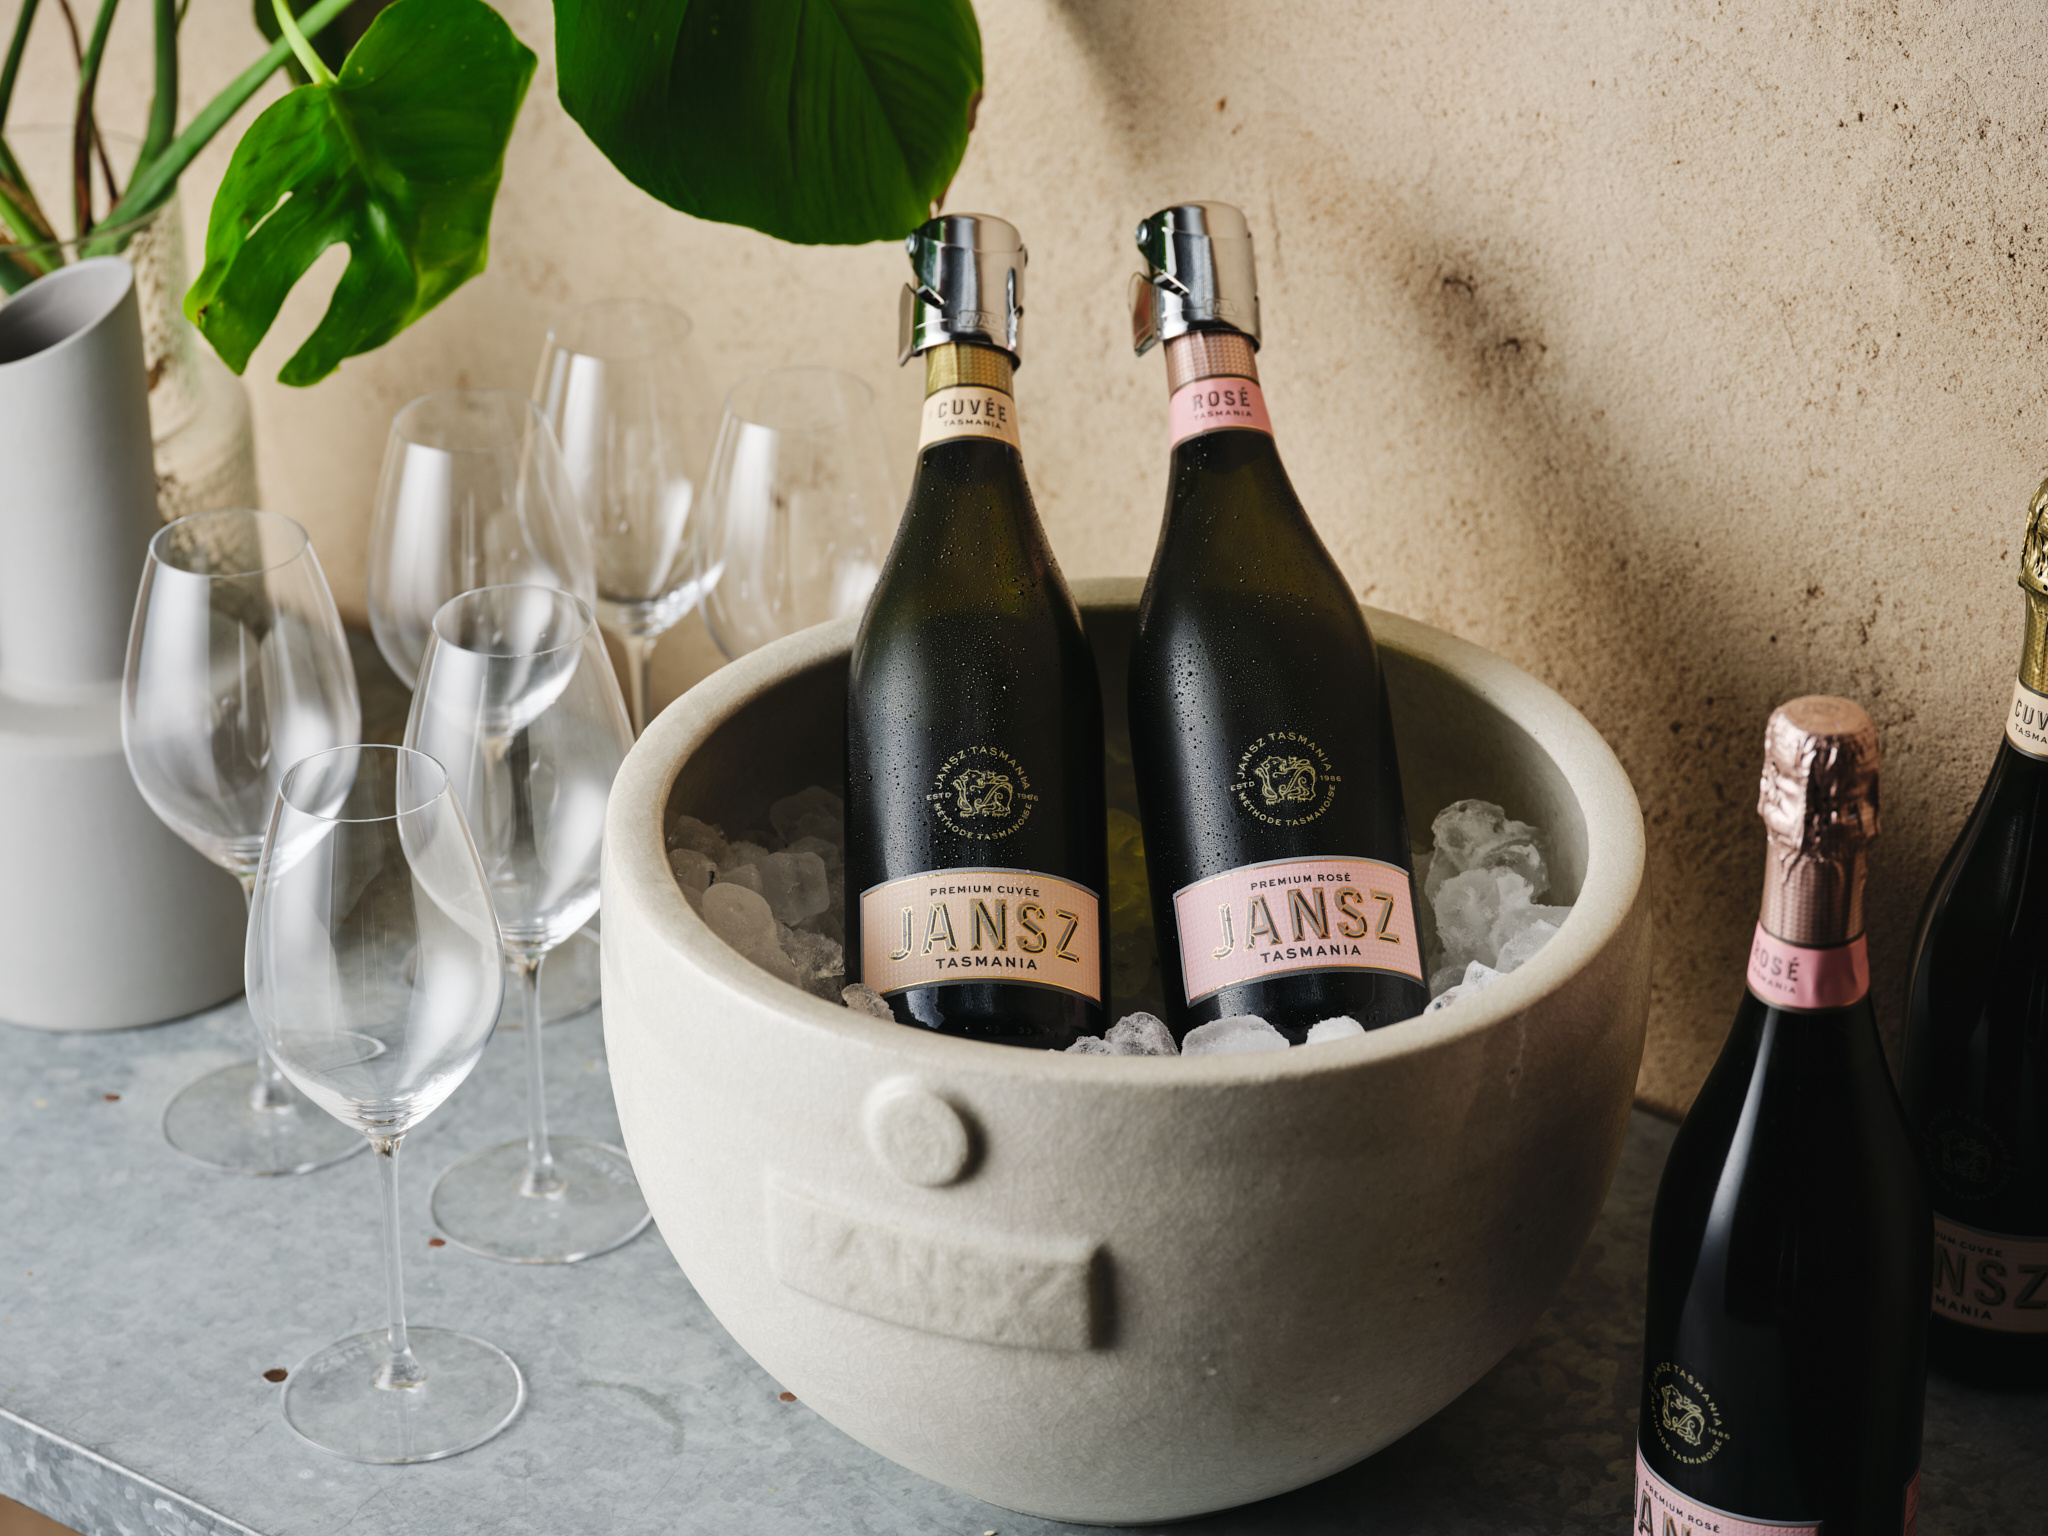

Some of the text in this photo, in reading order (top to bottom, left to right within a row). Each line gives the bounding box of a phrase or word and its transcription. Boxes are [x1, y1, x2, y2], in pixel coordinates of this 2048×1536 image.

[938, 397, 1007, 423] CUVÉE
[1193, 387, 1251, 412] ROSÉ
[943, 419, 1001, 430] TASMANIA
[1193, 410, 1253, 421] TASMANIA
[934, 746, 1030, 790] JANSZ TASMANIA
[1237, 732, 1332, 779] JANSZ TASMANIA
[926, 792, 951, 801] ESTD
[1230, 781, 1255, 791] ESTD
[1285, 784, 1336, 826] TASMANOISE
[977, 803, 1032, 841] TASMANOISE
[930, 885, 1040, 898] PREMIUM CUVÉE
[1250, 872, 1352, 891] PREMIUM ROSÉ
[888, 898, 1081, 965] JANSZ
[1211, 886, 1401, 960] JANSZ
[935, 956, 1038, 971] TASMANIA
[1260, 944, 1362, 964] TASMANIA
[1959, 1240, 2004, 1258] CUVÉE
[1674, 1364, 1722, 1427] TASMANIA
[1671, 1438, 1723, 1465] TASMANOISE
[1645, 1480, 1684, 1518] PREMIUM
[1687, 1514, 1721, 1535] ROSÉ
